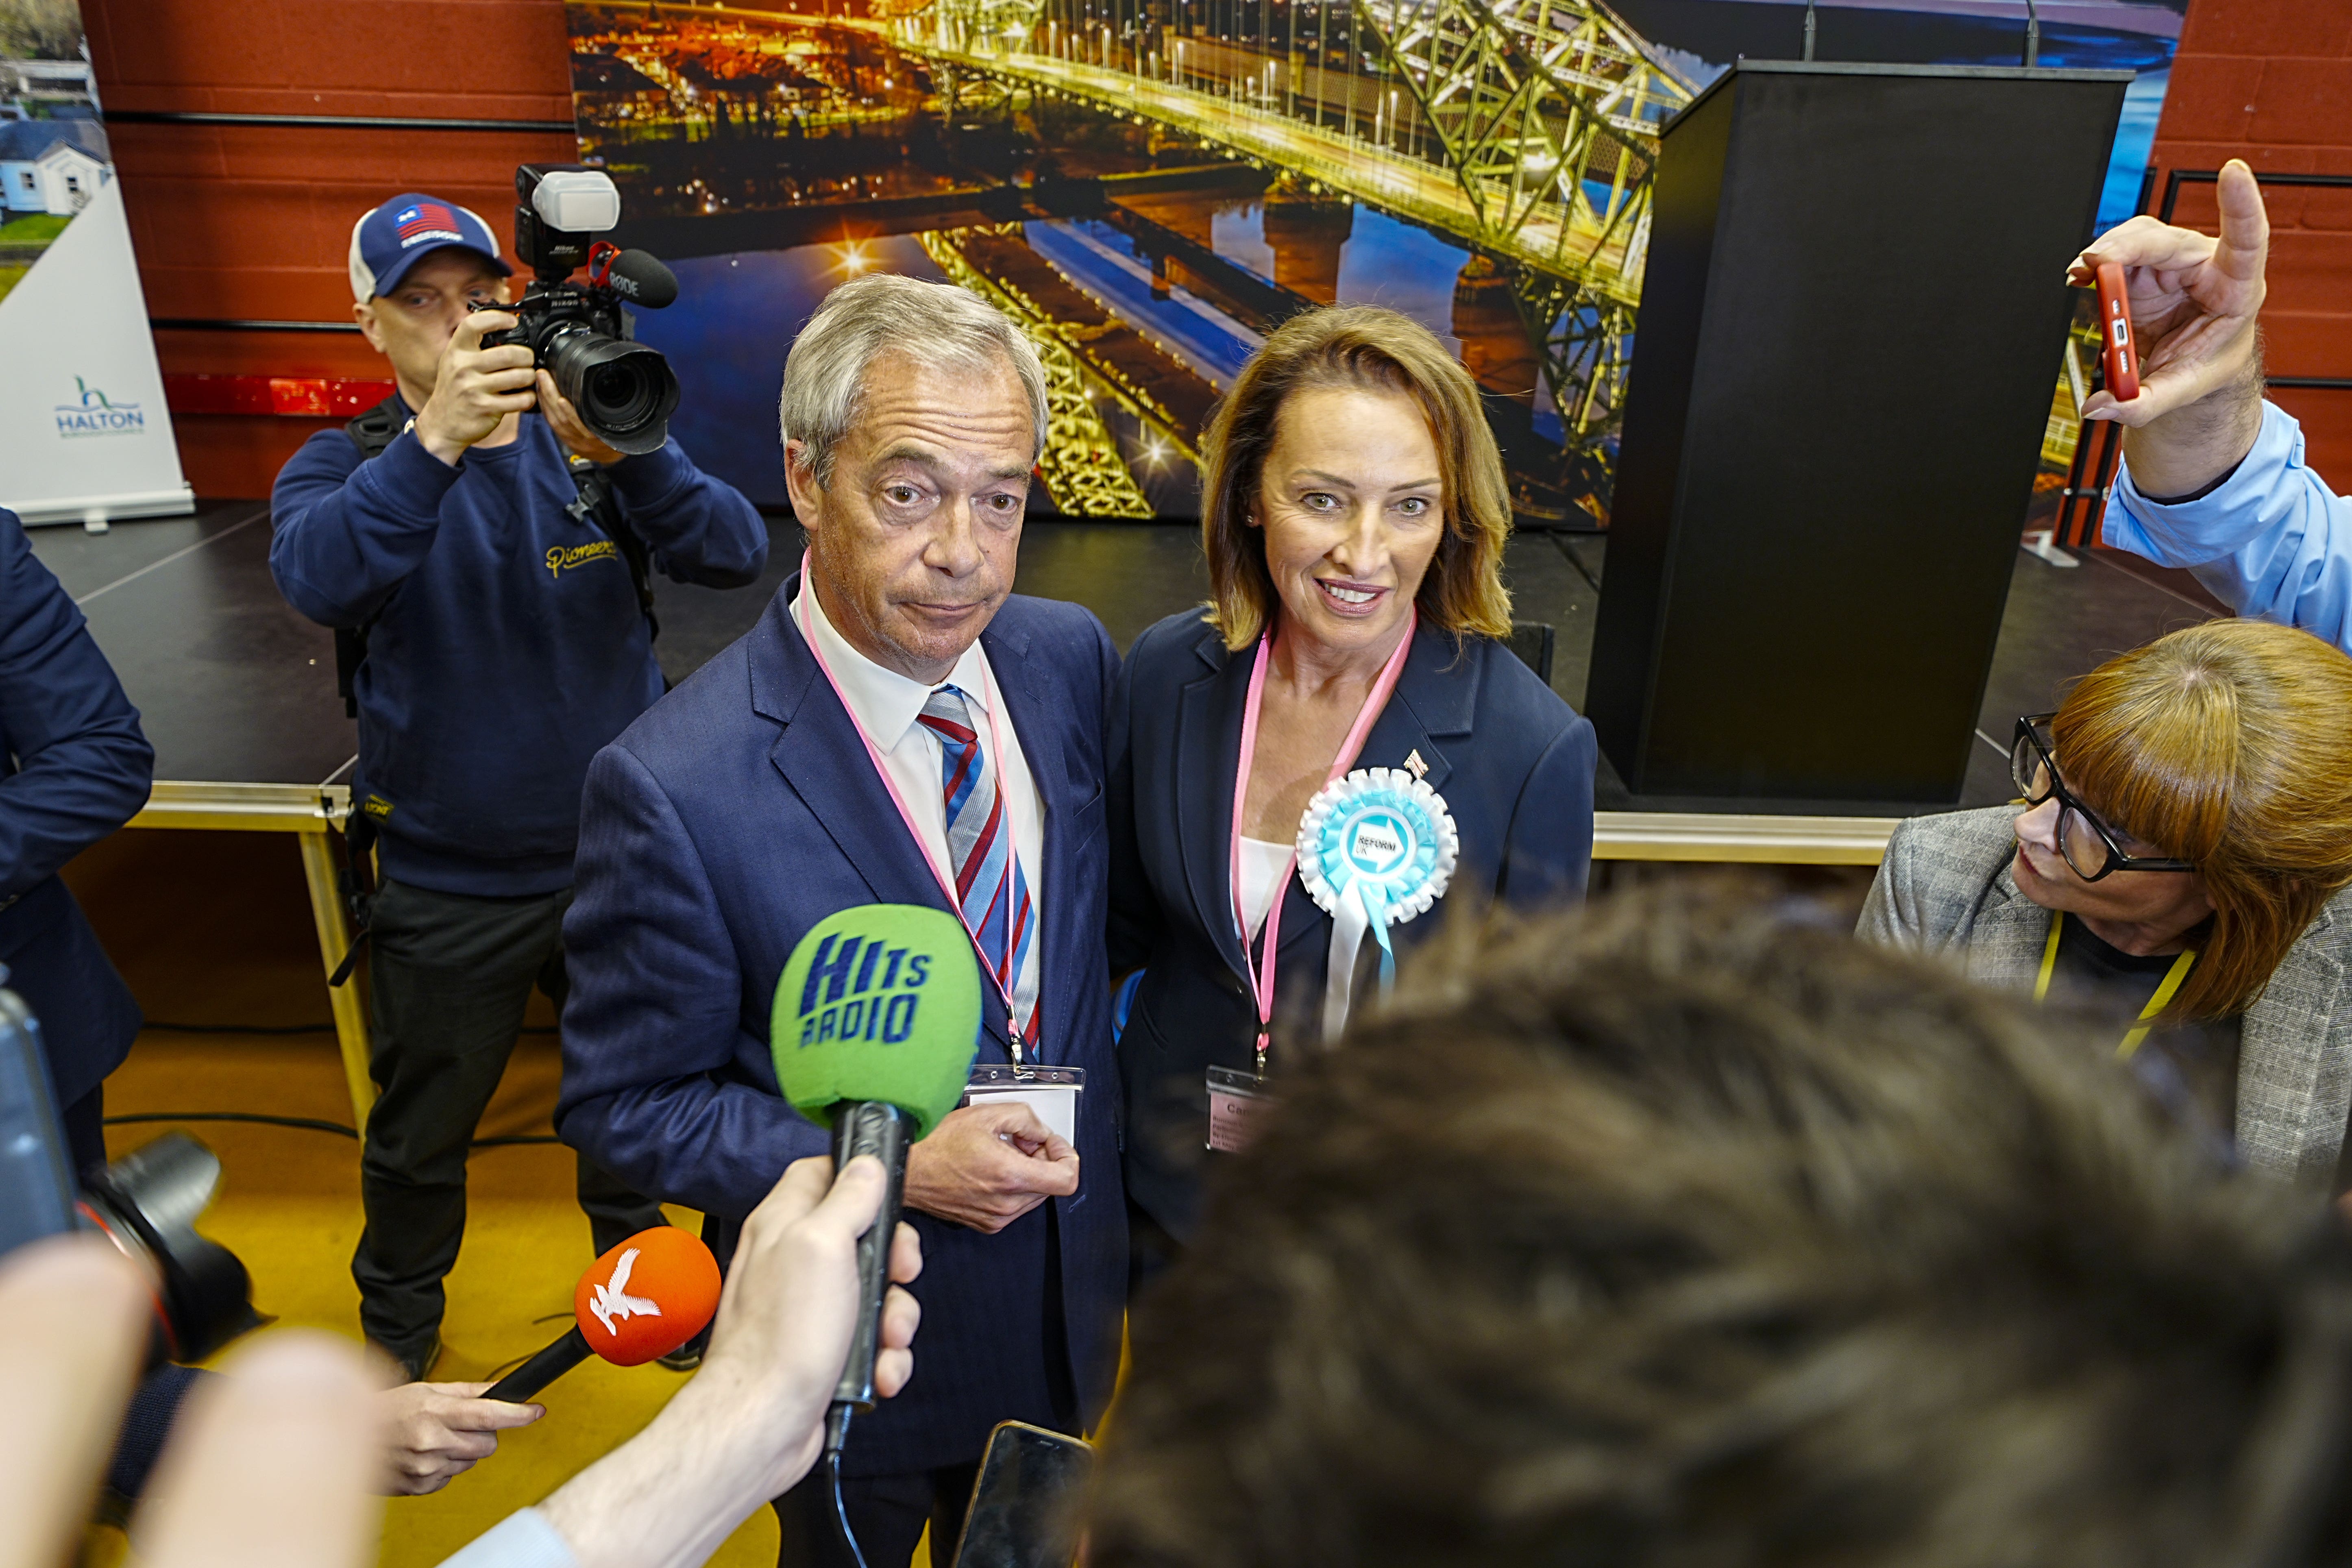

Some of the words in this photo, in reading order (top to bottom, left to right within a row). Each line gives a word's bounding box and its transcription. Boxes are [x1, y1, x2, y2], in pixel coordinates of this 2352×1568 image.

[57, 412, 144, 431] HALTON
[1356, 845, 1368, 856] UK
[1358, 835, 1396, 852] REFORM
[799, 993, 919, 1048] RADIO
